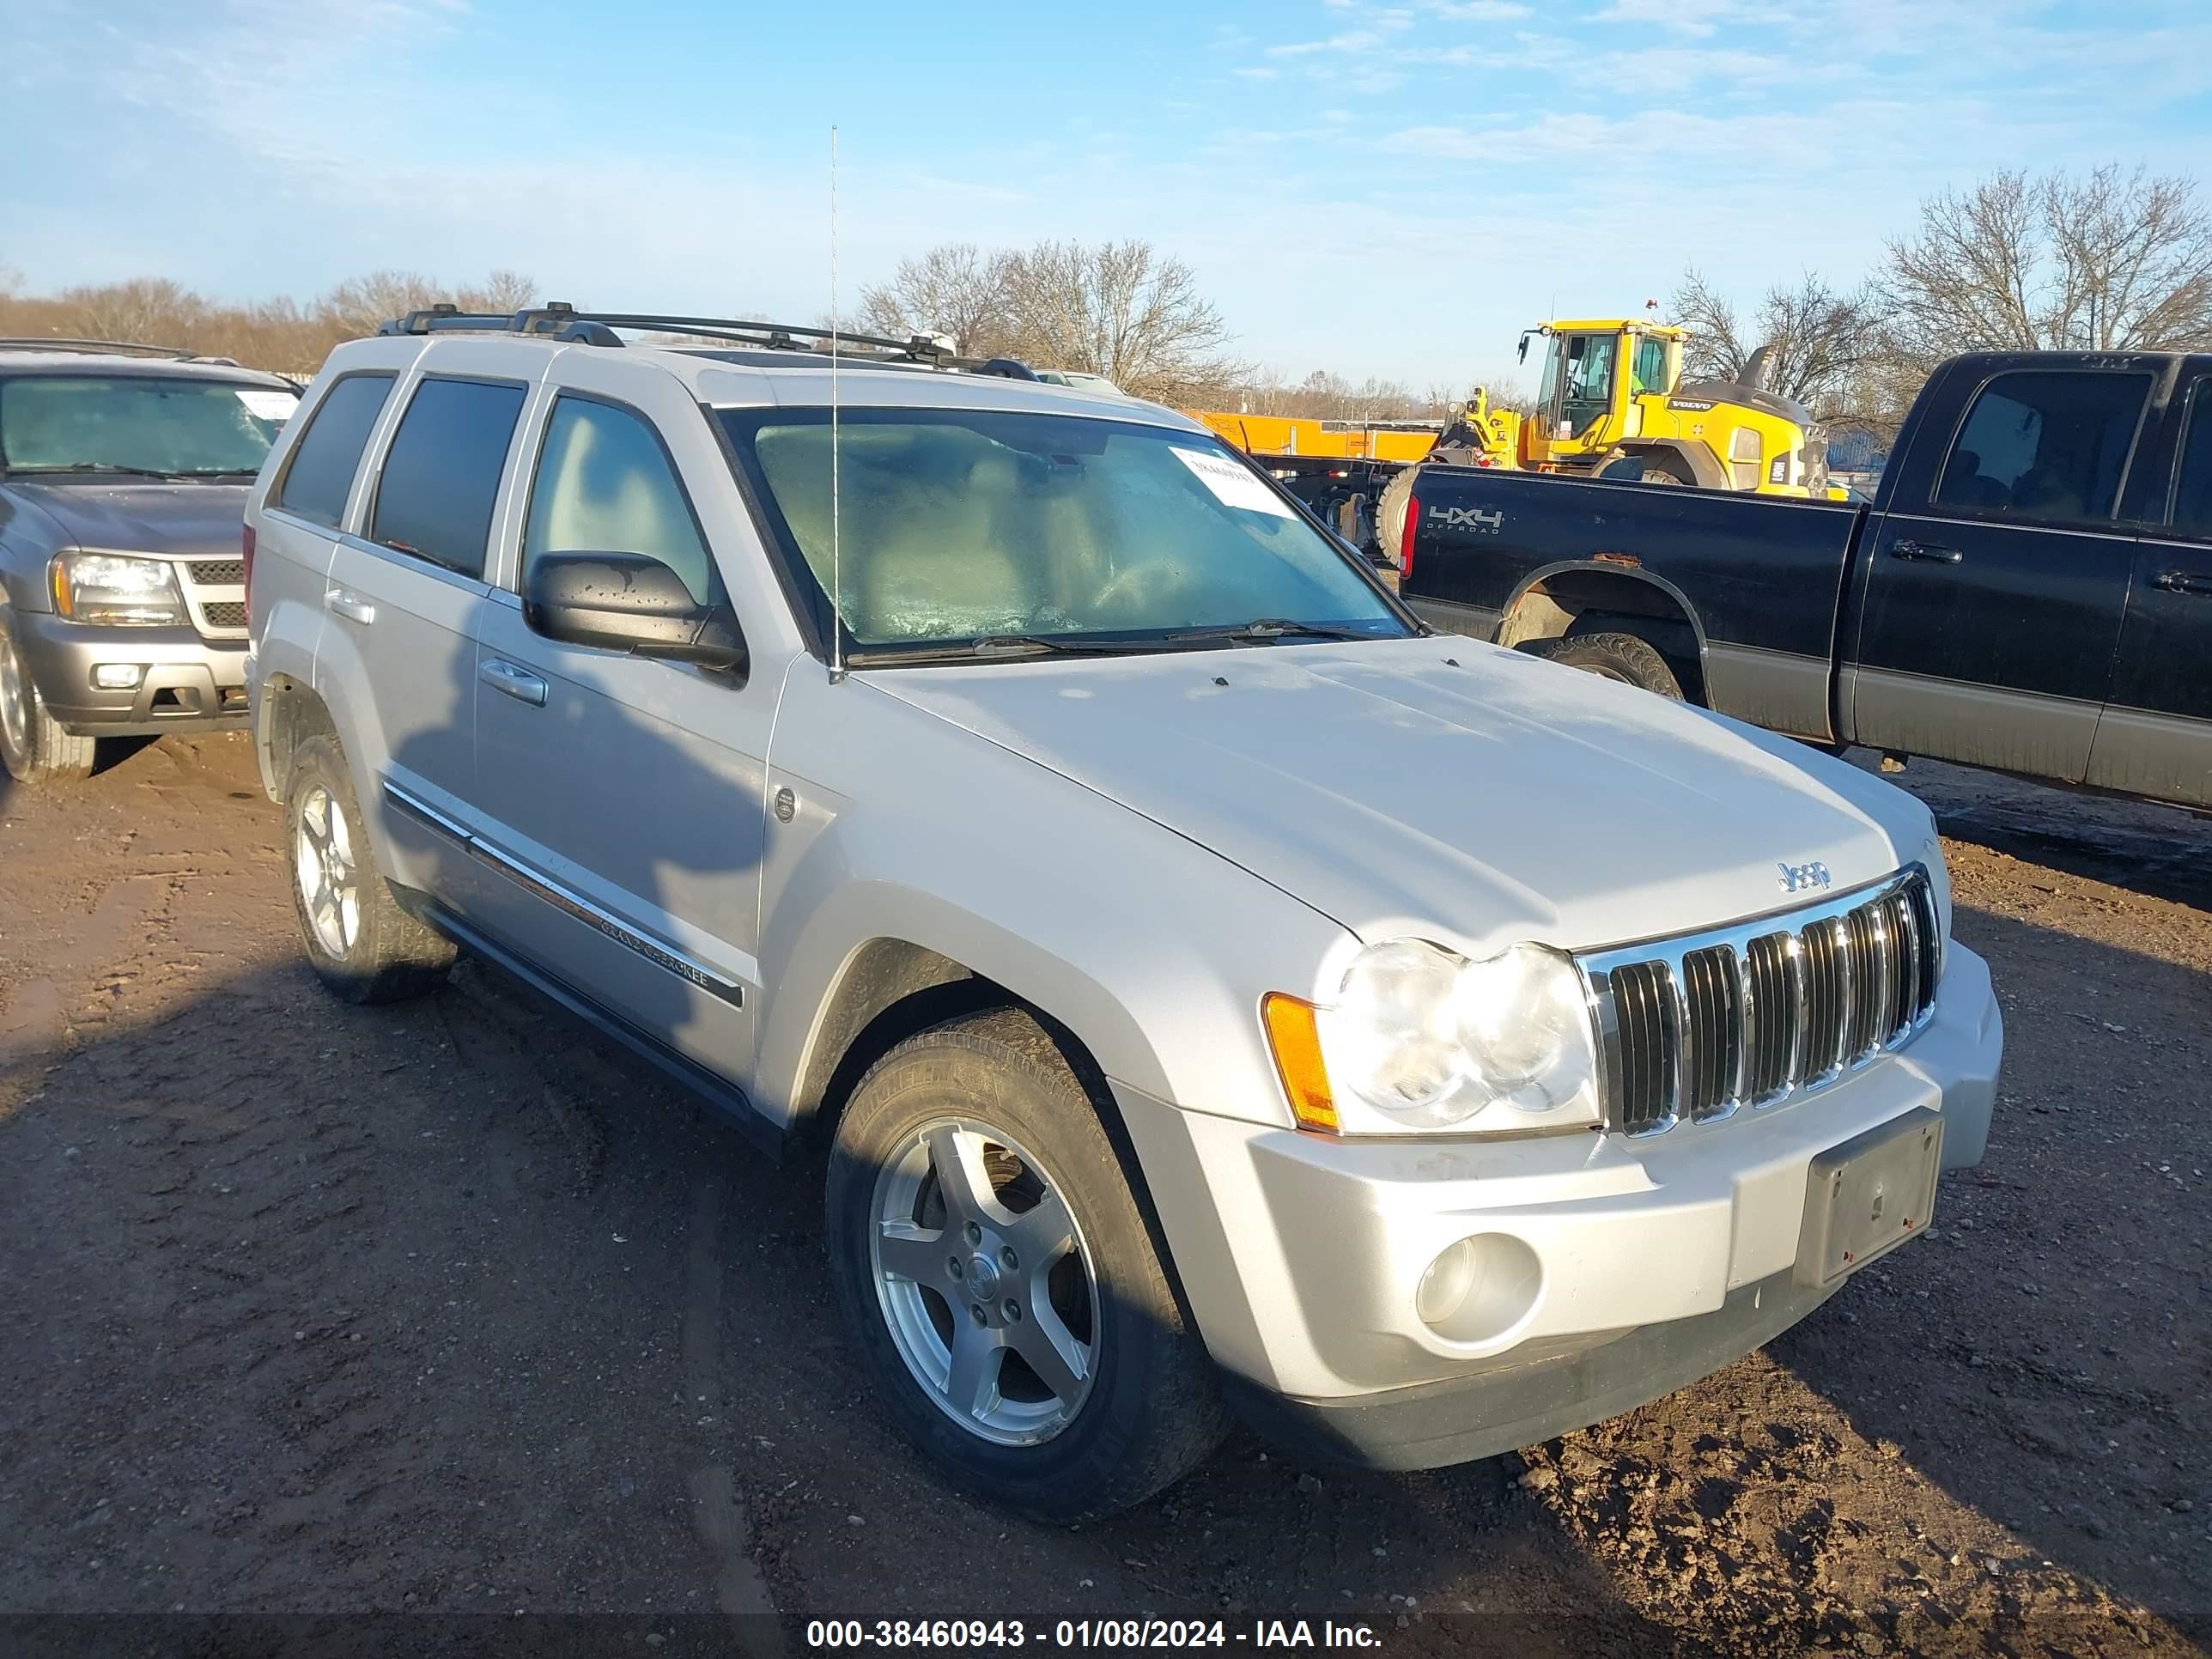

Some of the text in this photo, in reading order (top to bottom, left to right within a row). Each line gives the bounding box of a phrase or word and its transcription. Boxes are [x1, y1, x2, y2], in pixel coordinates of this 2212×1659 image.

[1672, 400, 1711, 410] VOLVO
[1771, 461, 1786, 482] L90H
[1426, 522, 1500, 535] OFFROAD
[1777, 861, 1832, 892] Jeep
[601, 920, 708, 988] GRAND CHEROKEE
